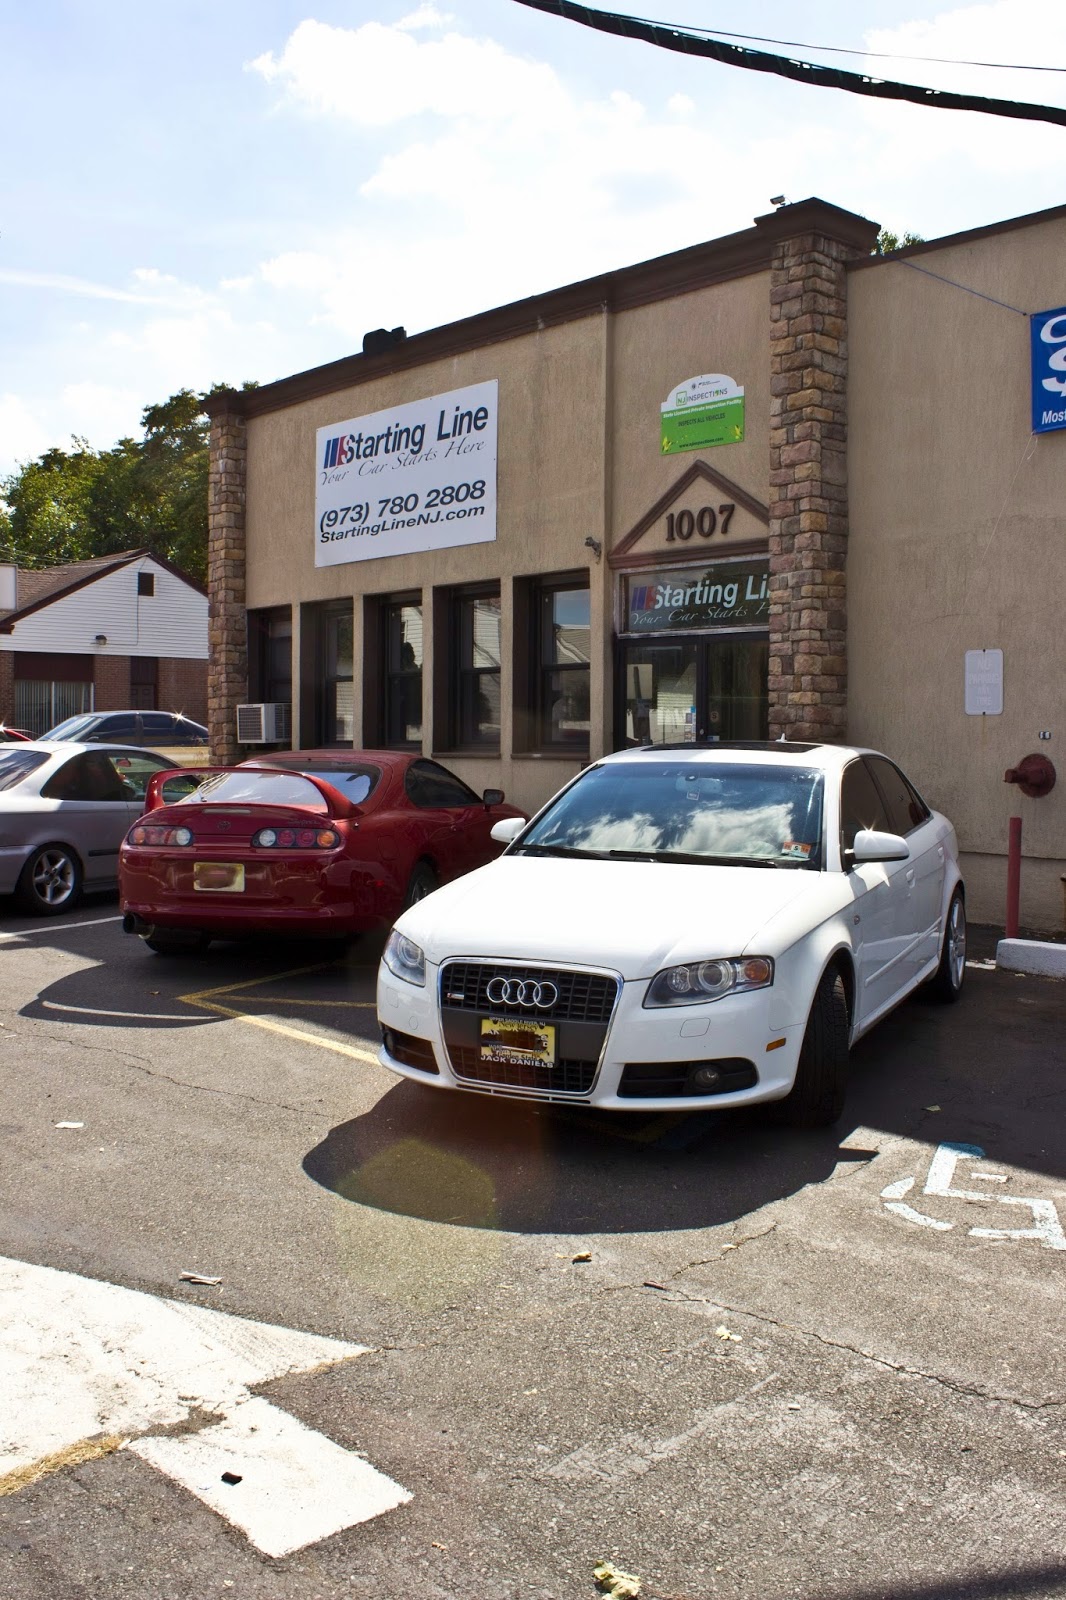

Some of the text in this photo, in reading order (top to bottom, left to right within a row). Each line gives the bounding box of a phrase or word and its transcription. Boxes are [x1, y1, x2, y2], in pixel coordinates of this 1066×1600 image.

[341, 405, 489, 464] Starting Line
[319, 436, 487, 486] Your Car Starts Here
[320, 479, 486, 533] (973) 780 2808
[320, 505, 485, 543] StartingLineNJ.com
[665, 503, 736, 542] 1007
[654, 579, 739, 610] Starting
[745, 573, 770, 601] Li
[631, 612, 662, 625] Your
[668, 608, 698, 622] Car
[703, 605, 748, 620] Starts
[480, 1055, 507, 1063] JACK
